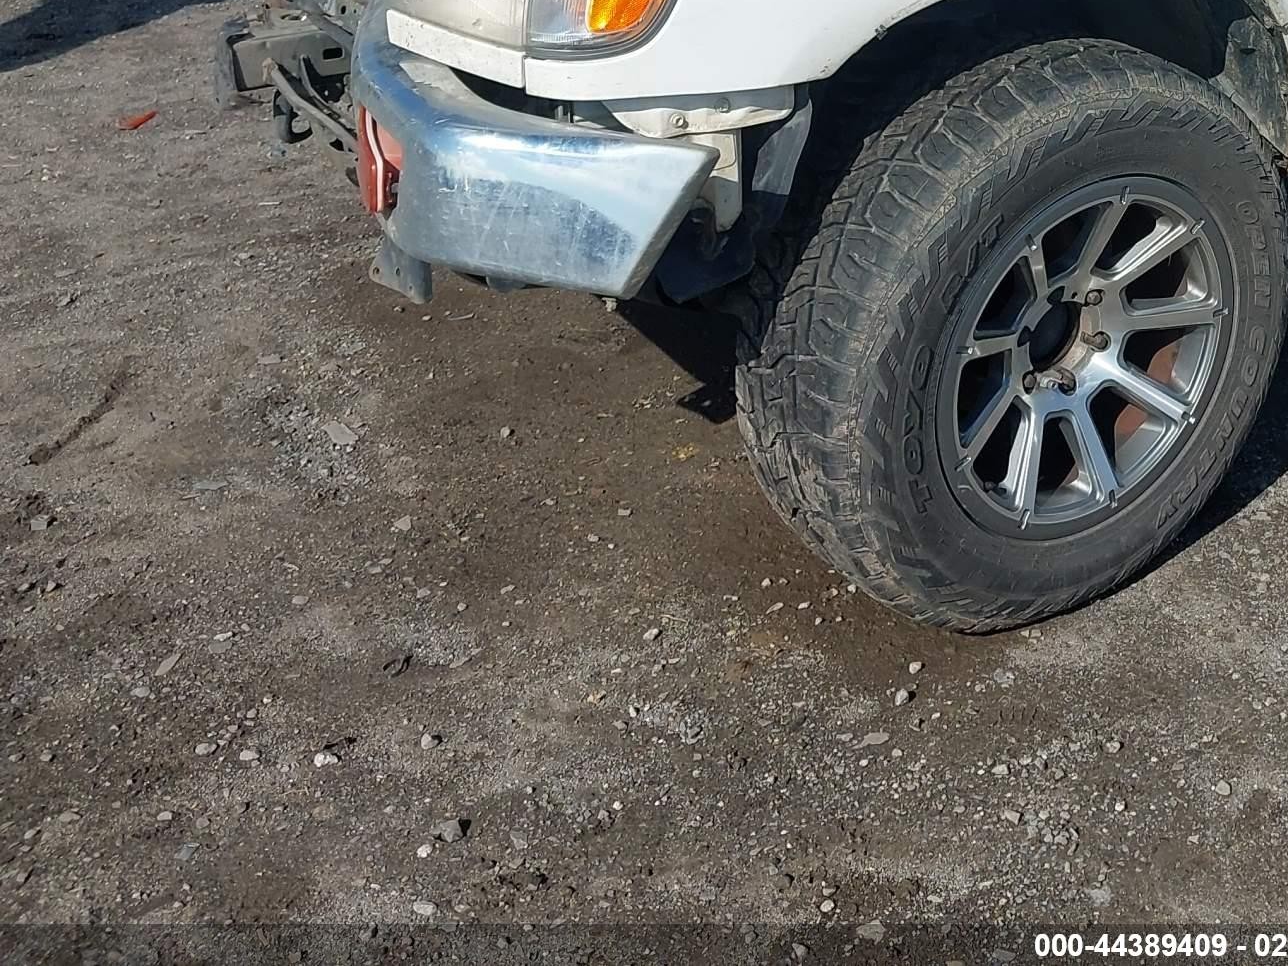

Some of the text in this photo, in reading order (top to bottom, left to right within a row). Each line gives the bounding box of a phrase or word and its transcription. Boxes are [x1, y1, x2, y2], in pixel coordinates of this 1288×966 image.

[903, 344, 934, 514] TOYO
[1155, 200, 1271, 531] OPEN COUNTRY
